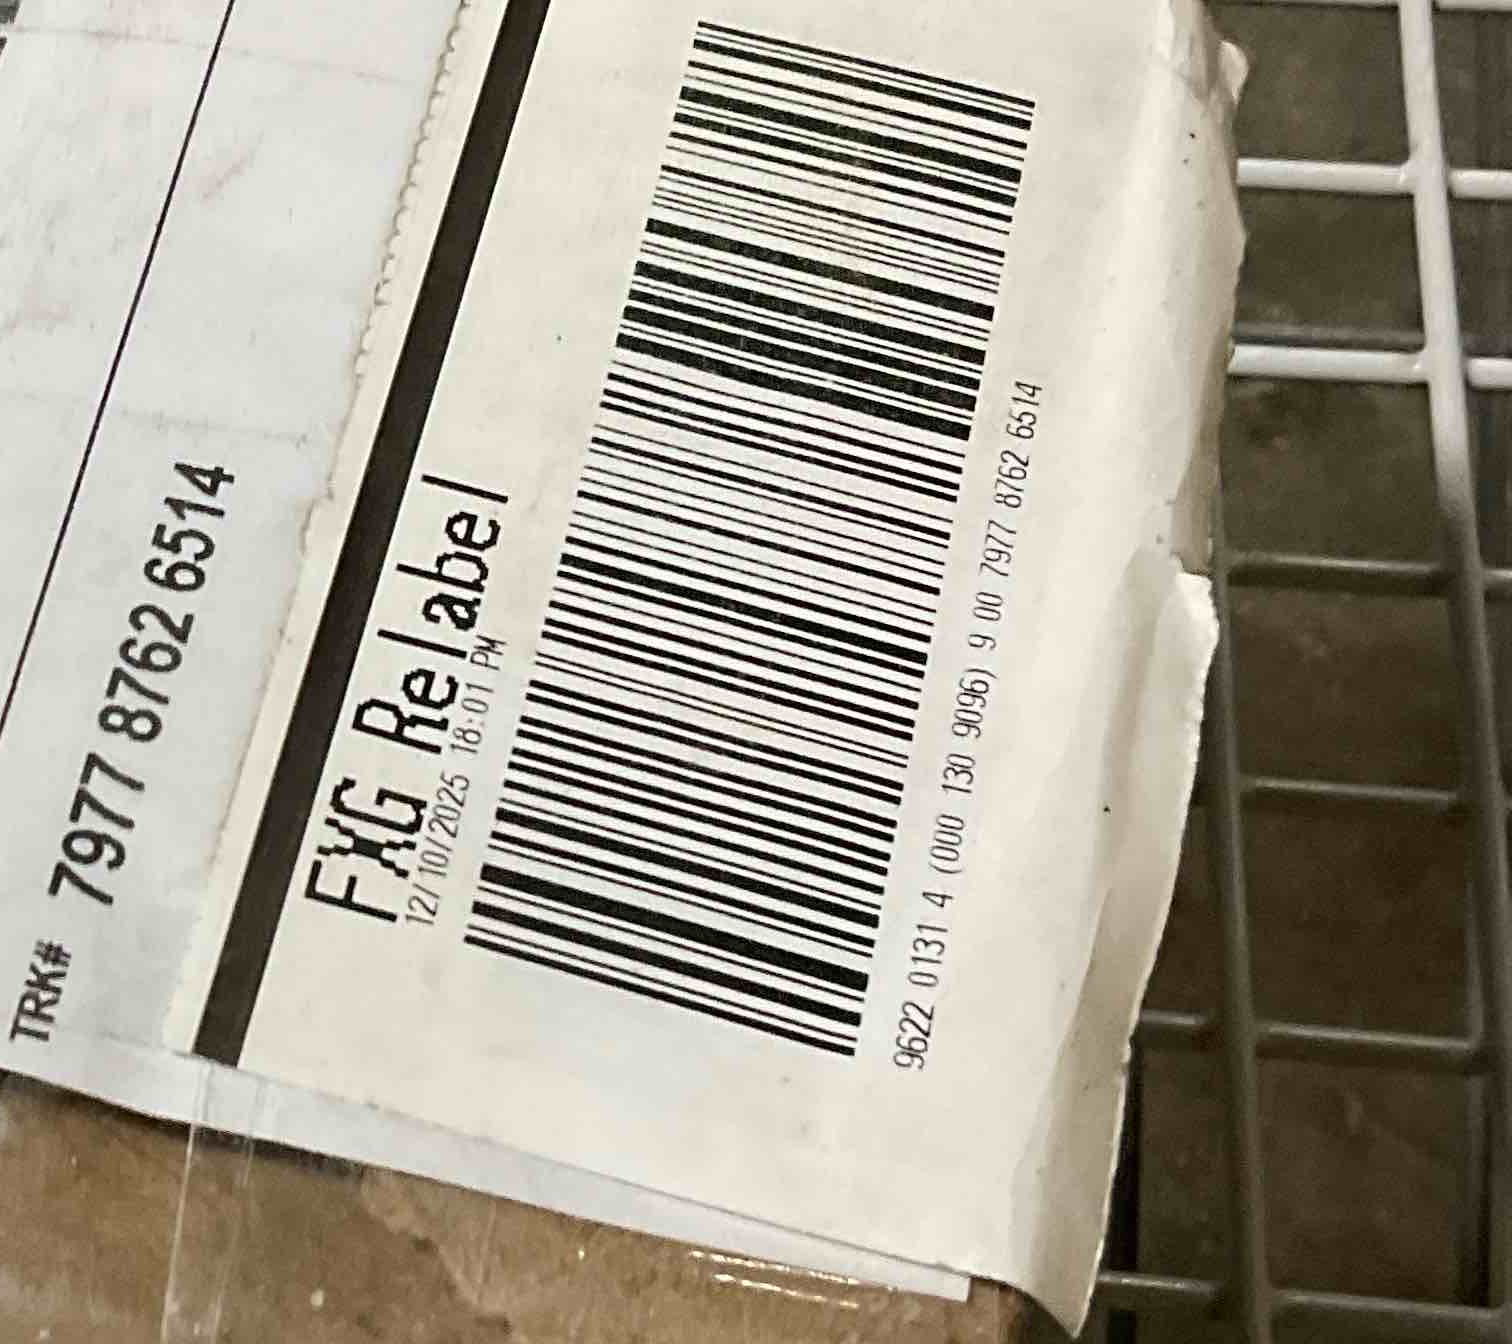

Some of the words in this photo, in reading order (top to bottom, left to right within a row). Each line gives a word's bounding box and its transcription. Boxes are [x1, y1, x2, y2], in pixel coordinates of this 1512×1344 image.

[1006, 380, 1043, 440] 6514
[995, 449, 1030, 509] 8762
[143, 461, 234, 593] 6514
[980, 519, 1017, 577] 7977
[352, 473, 509, 754] Relabel
[973, 591, 1004, 622] 00
[98, 603, 194, 744] 8762
[968, 633, 997, 650] 9
[952, 667, 997, 738] 9096)
[405, 772, 471, 926] 12/10/2025
[449, 682, 494, 754] 18:01
[472, 633, 508, 671] PM
[942, 753, 977, 795] 130
[47, 751, 146, 906] 7977
[304, 777, 427, 922] FXG
[929, 814, 965, 875] (000
[921, 890, 954, 908] 4
[907, 923, 948, 988] 0131
[9, 938, 72, 1043] TRK#
[892, 1000, 935, 1070] 9622
